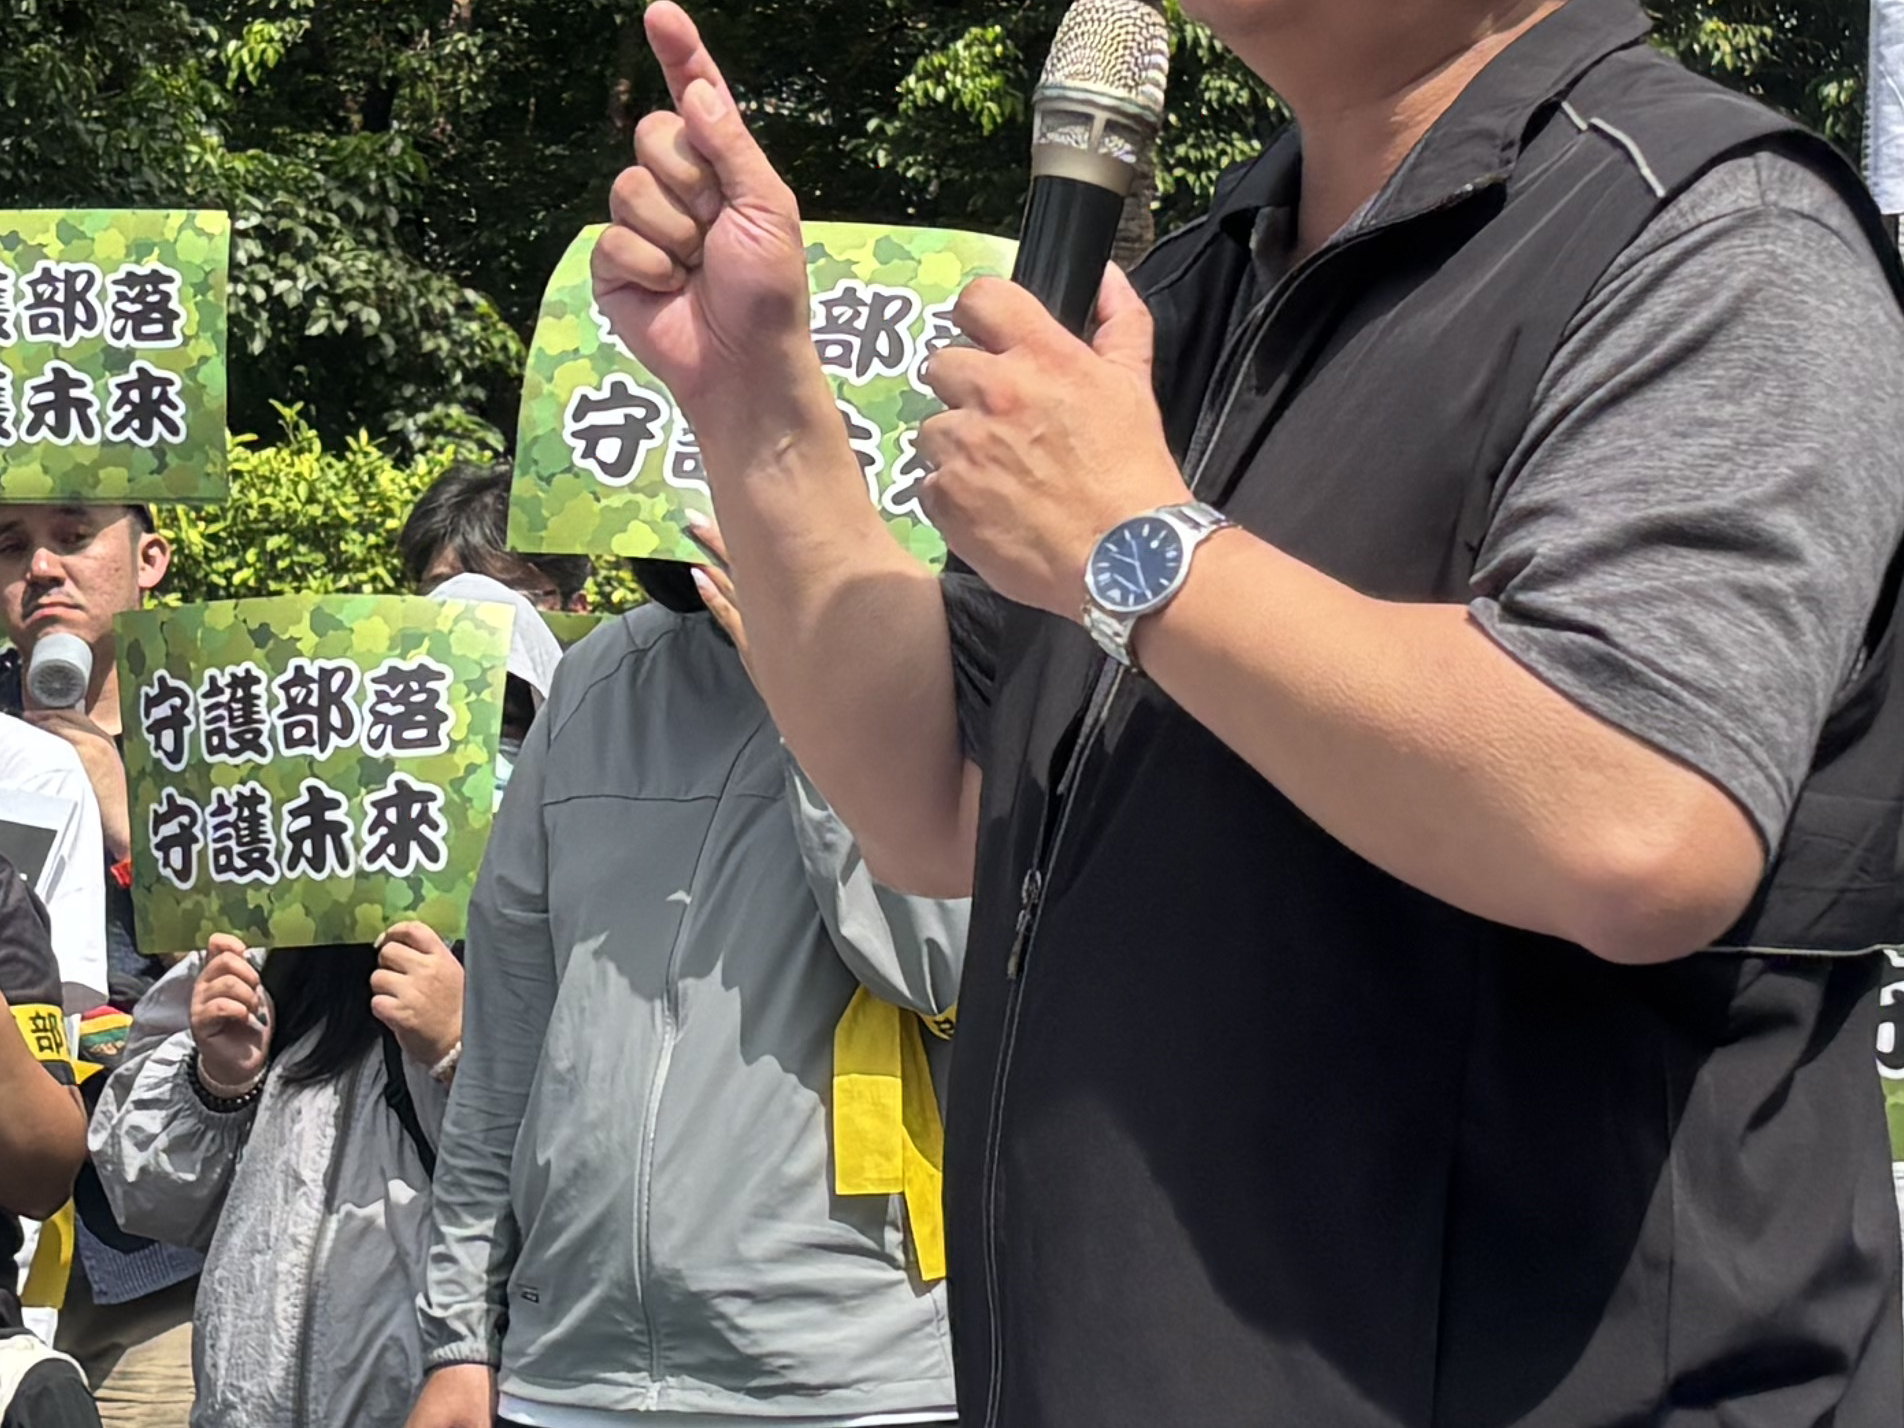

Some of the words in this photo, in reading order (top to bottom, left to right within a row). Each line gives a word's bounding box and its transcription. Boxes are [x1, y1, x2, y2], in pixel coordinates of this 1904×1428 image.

[142, 663, 452, 764] 守護部落
[152, 776, 445, 884] 守護未來
